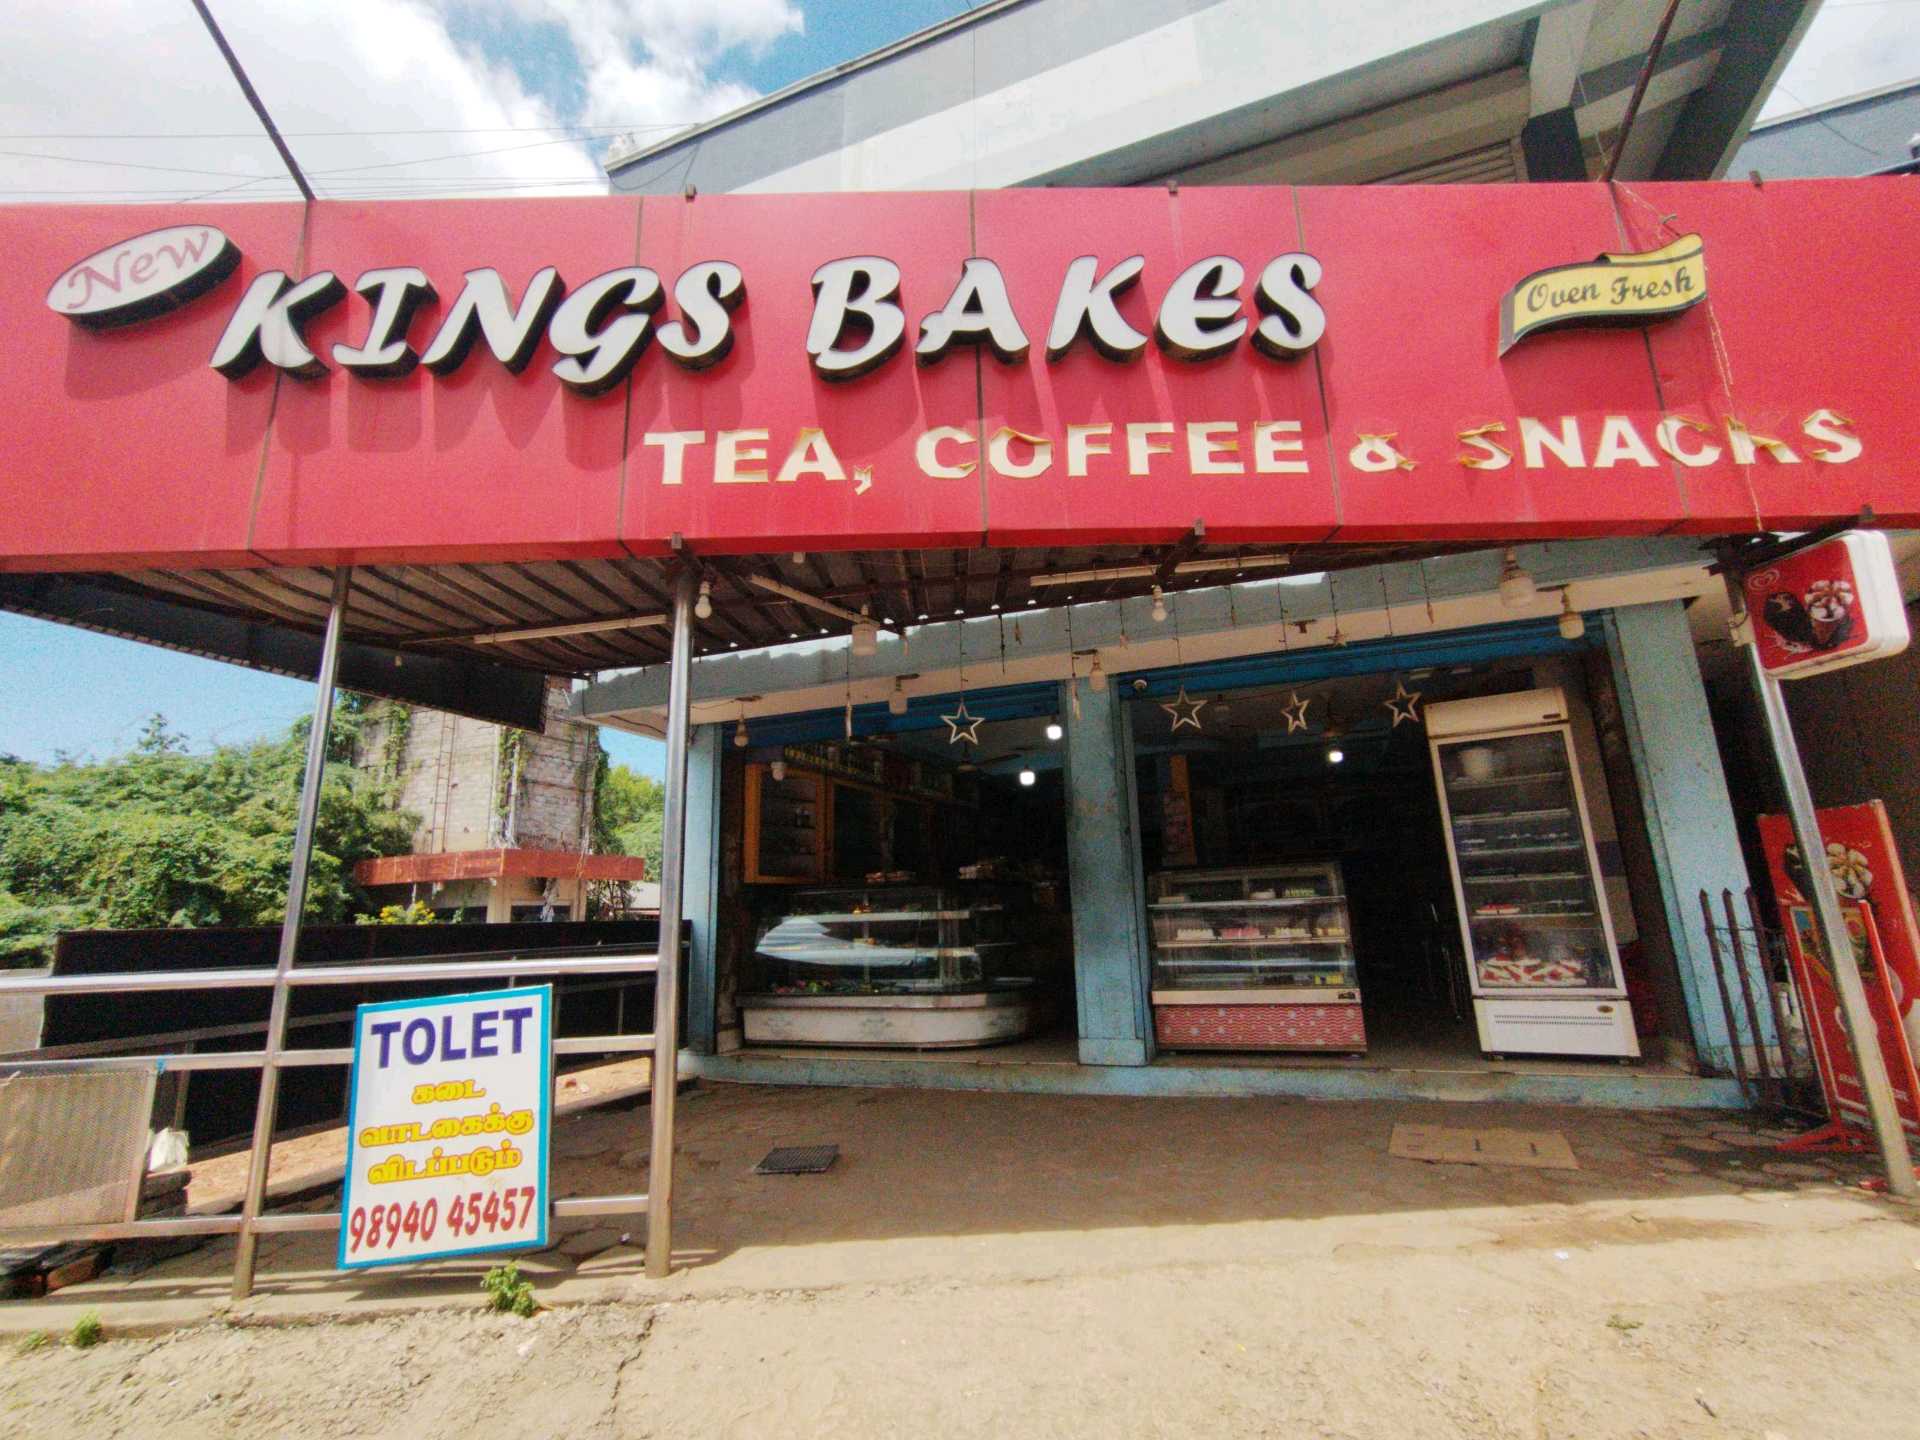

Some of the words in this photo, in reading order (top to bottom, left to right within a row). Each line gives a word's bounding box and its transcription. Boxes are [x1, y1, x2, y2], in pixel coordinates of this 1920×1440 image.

[66, 229, 212, 311] New
[1526, 279, 1601, 313] Oven
[1609, 267, 1697, 308] Fresh
[210, 260, 745, 388] KINGS
[807, 252, 1327, 373] BAKES
[644, 426, 874, 495] TEA,
[914, 420, 1310, 479] COFFEE
[1348, 431, 1416, 472] &
[369, 1006, 534, 1069] TOLET
[411, 1077, 486, 1106] கடை
[358, 1102, 535, 1148] வாடகைக்கு
[367, 1139, 524, 1185] விடப்படும்
[349, 1196, 439, 1254] 98940
[446, 1185, 536, 1237] 45457
